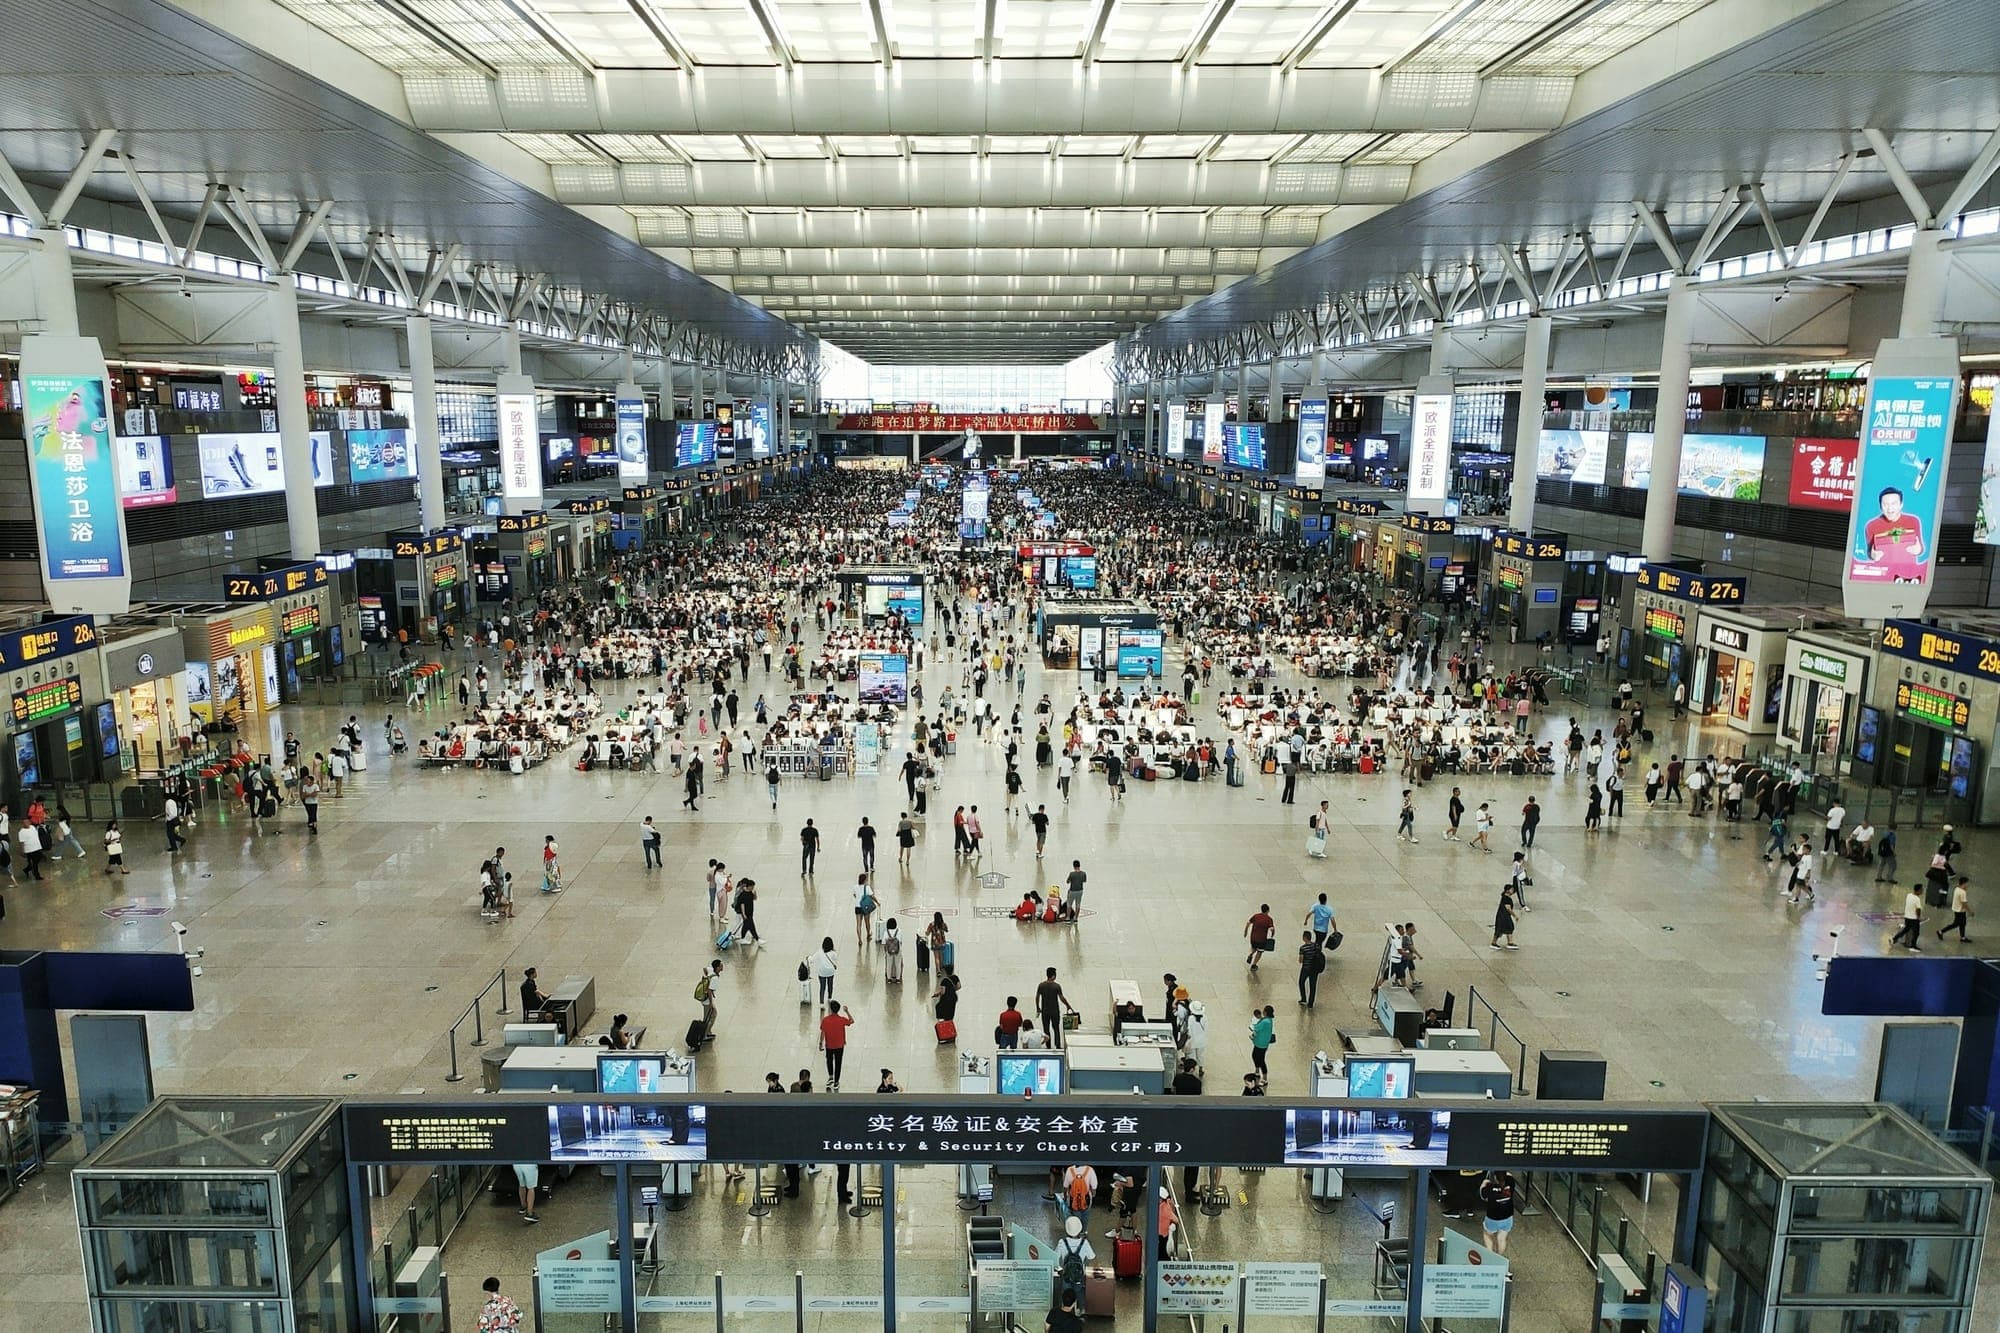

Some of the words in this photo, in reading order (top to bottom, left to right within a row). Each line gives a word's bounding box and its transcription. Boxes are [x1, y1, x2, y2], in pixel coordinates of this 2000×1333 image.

[856, 415, 962, 429] 奔跑在追梦路上
[972, 415, 1077, 429] 幸福从虹桥出发
[510, 410, 527, 488] 欧派全屋定制
[1420, 410, 1438, 489] 欧派全屋定制
[61, 430, 95, 542] 法恩莎卫浴
[571, 502, 588, 512] 21A
[501, 519, 519, 529] 23A
[1433, 521, 1451, 531] 23B
[397, 543, 419, 555] 25A
[1538, 544, 1562, 557] 25B
[230, 580, 259, 596] 27A
[1689, 580, 1704, 598] 27B
[1711, 583, 1739, 599] 27B
[37, 631, 59, 647] 检票口
[73, 623, 95, 645] 28A
[1882, 626, 1904, 649] 28B
[1936, 637, 1961, 655] 检票口
[867, 1114, 1140, 1134] 实名验证&安全检查
[822, 1140, 906, 1153] Identity
[917, 1141, 929, 1152] &
[940, 1140, 1025, 1153] Security
[1036, 1140, 1090, 1152] Check
